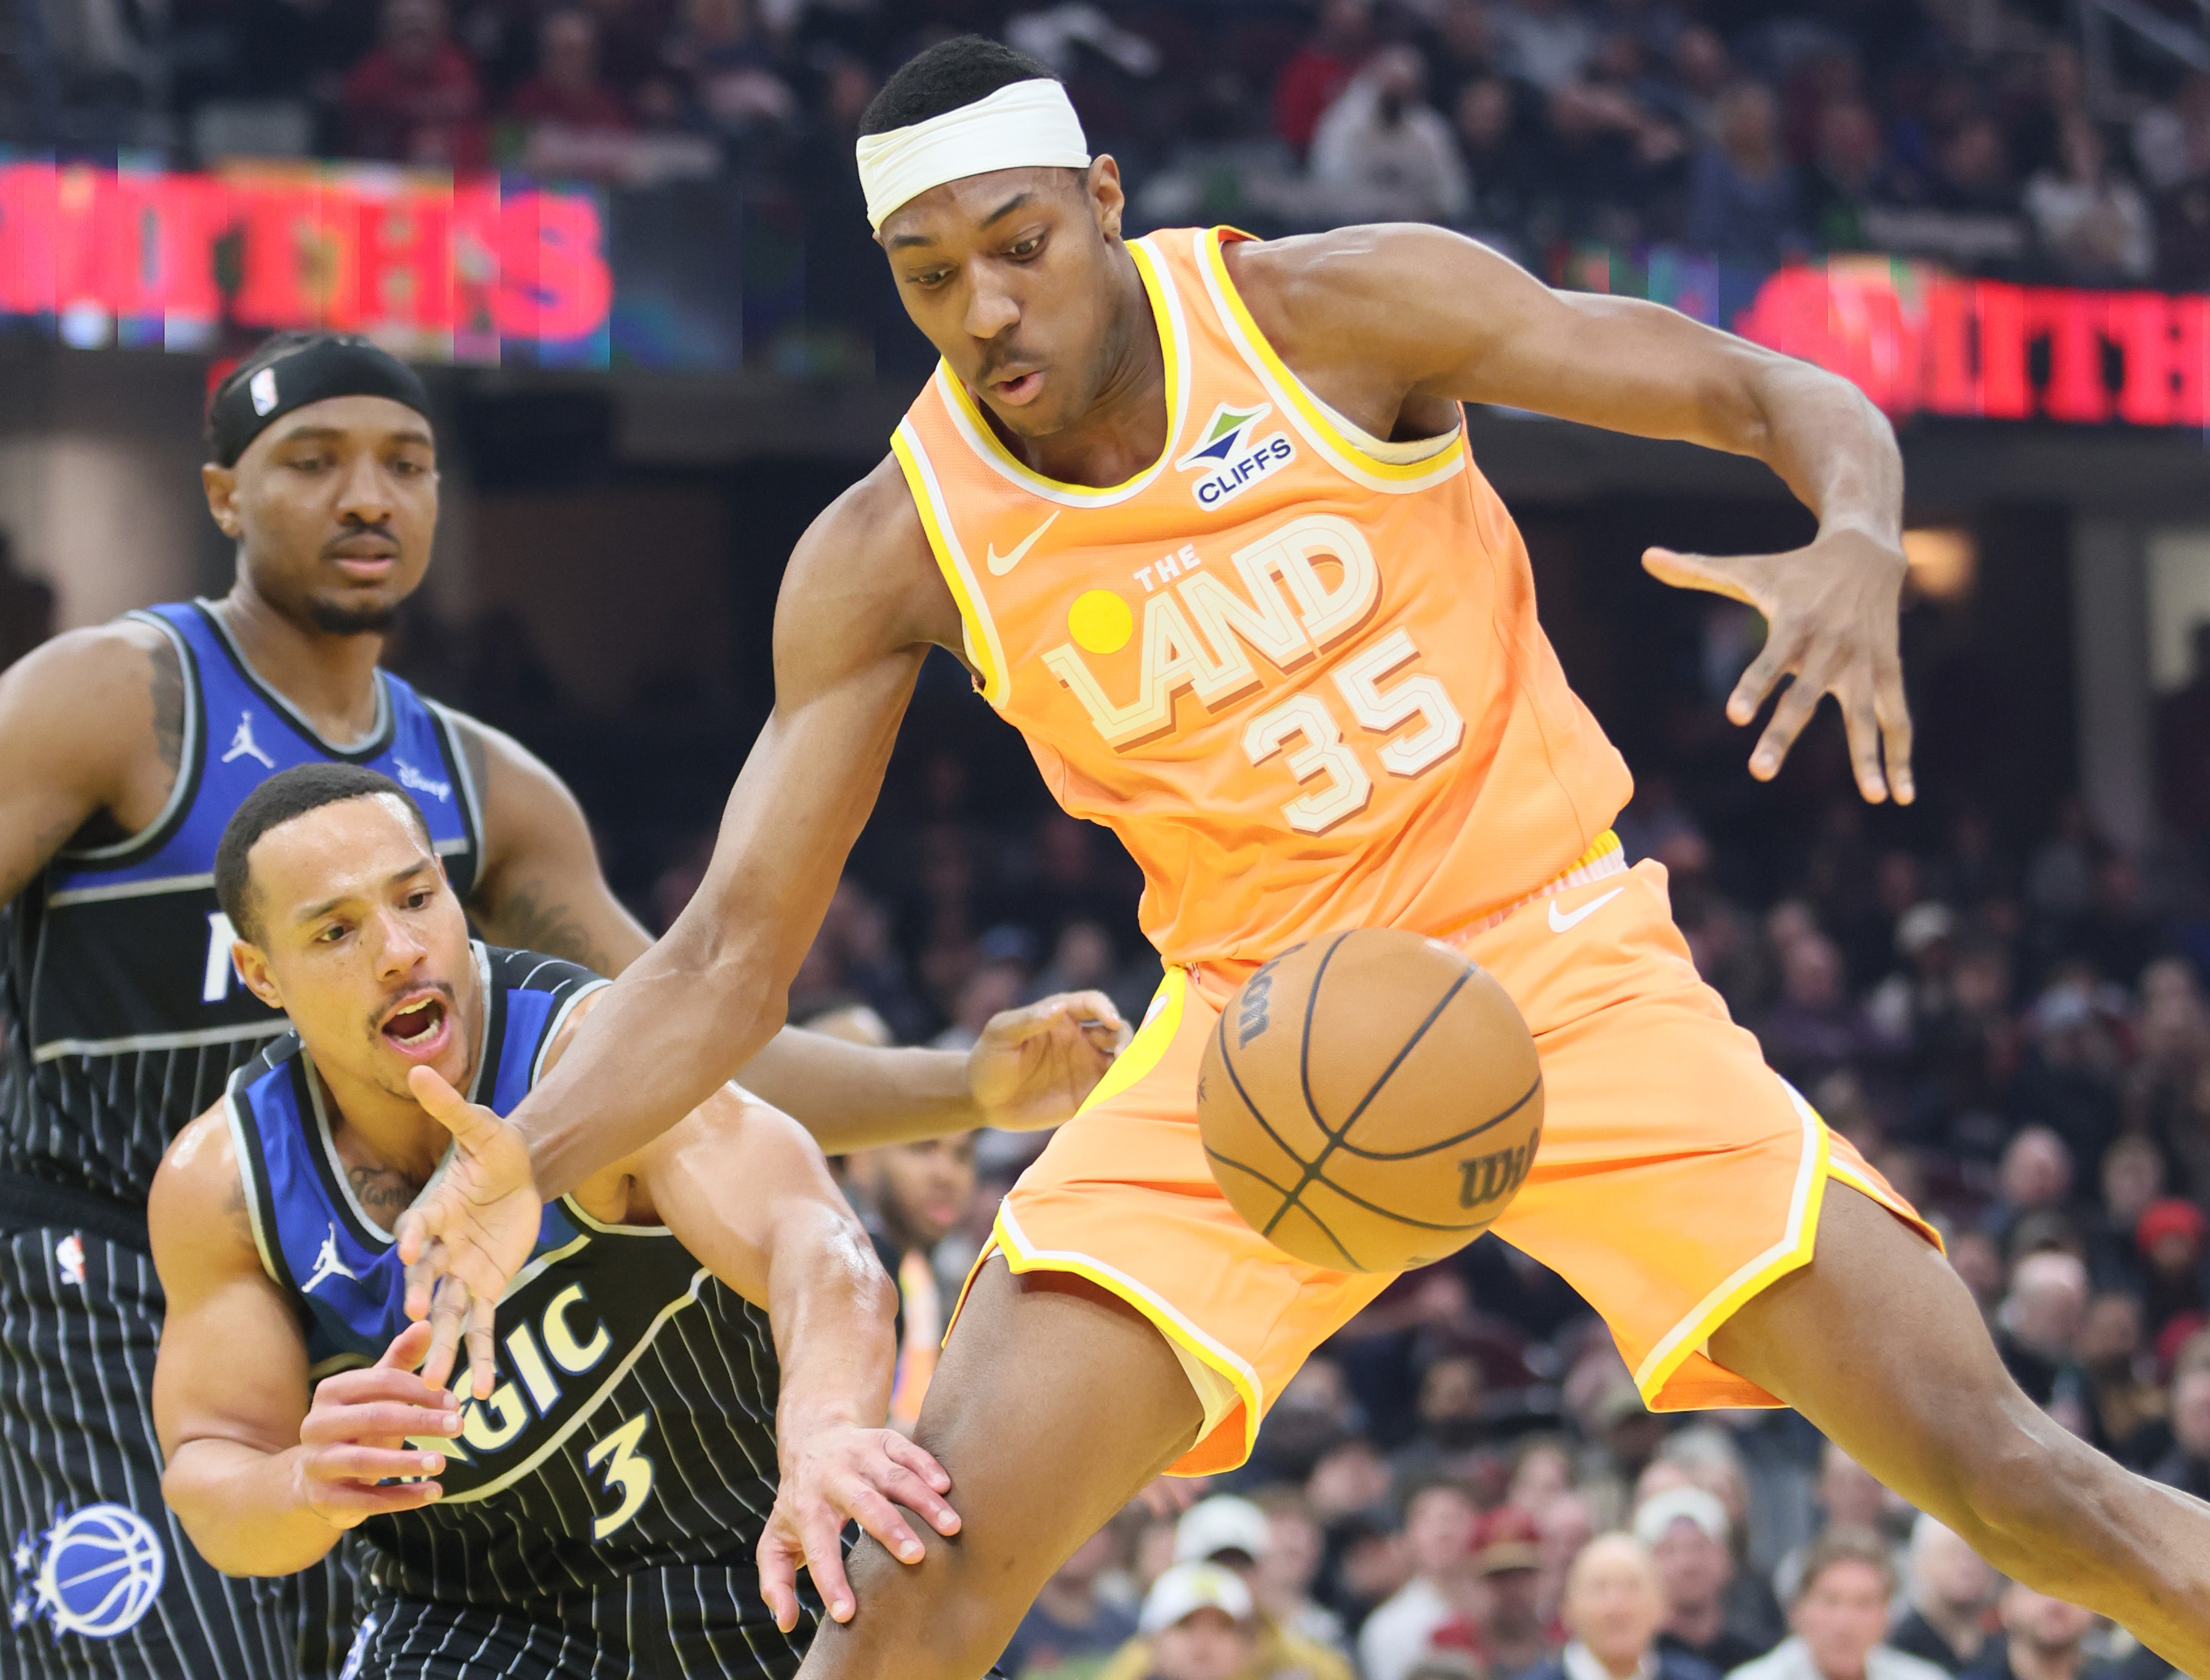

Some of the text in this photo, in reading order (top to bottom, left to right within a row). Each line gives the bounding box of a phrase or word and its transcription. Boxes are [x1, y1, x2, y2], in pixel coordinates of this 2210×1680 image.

[1197, 438, 1292, 505] CLIFFS
[1039, 513, 1384, 755] LAND
[1133, 543, 1201, 593] THE
[1242, 627, 1465, 837] 35
[394, 1281, 612, 1477] GIC
[584, 1406, 657, 1545] 3
